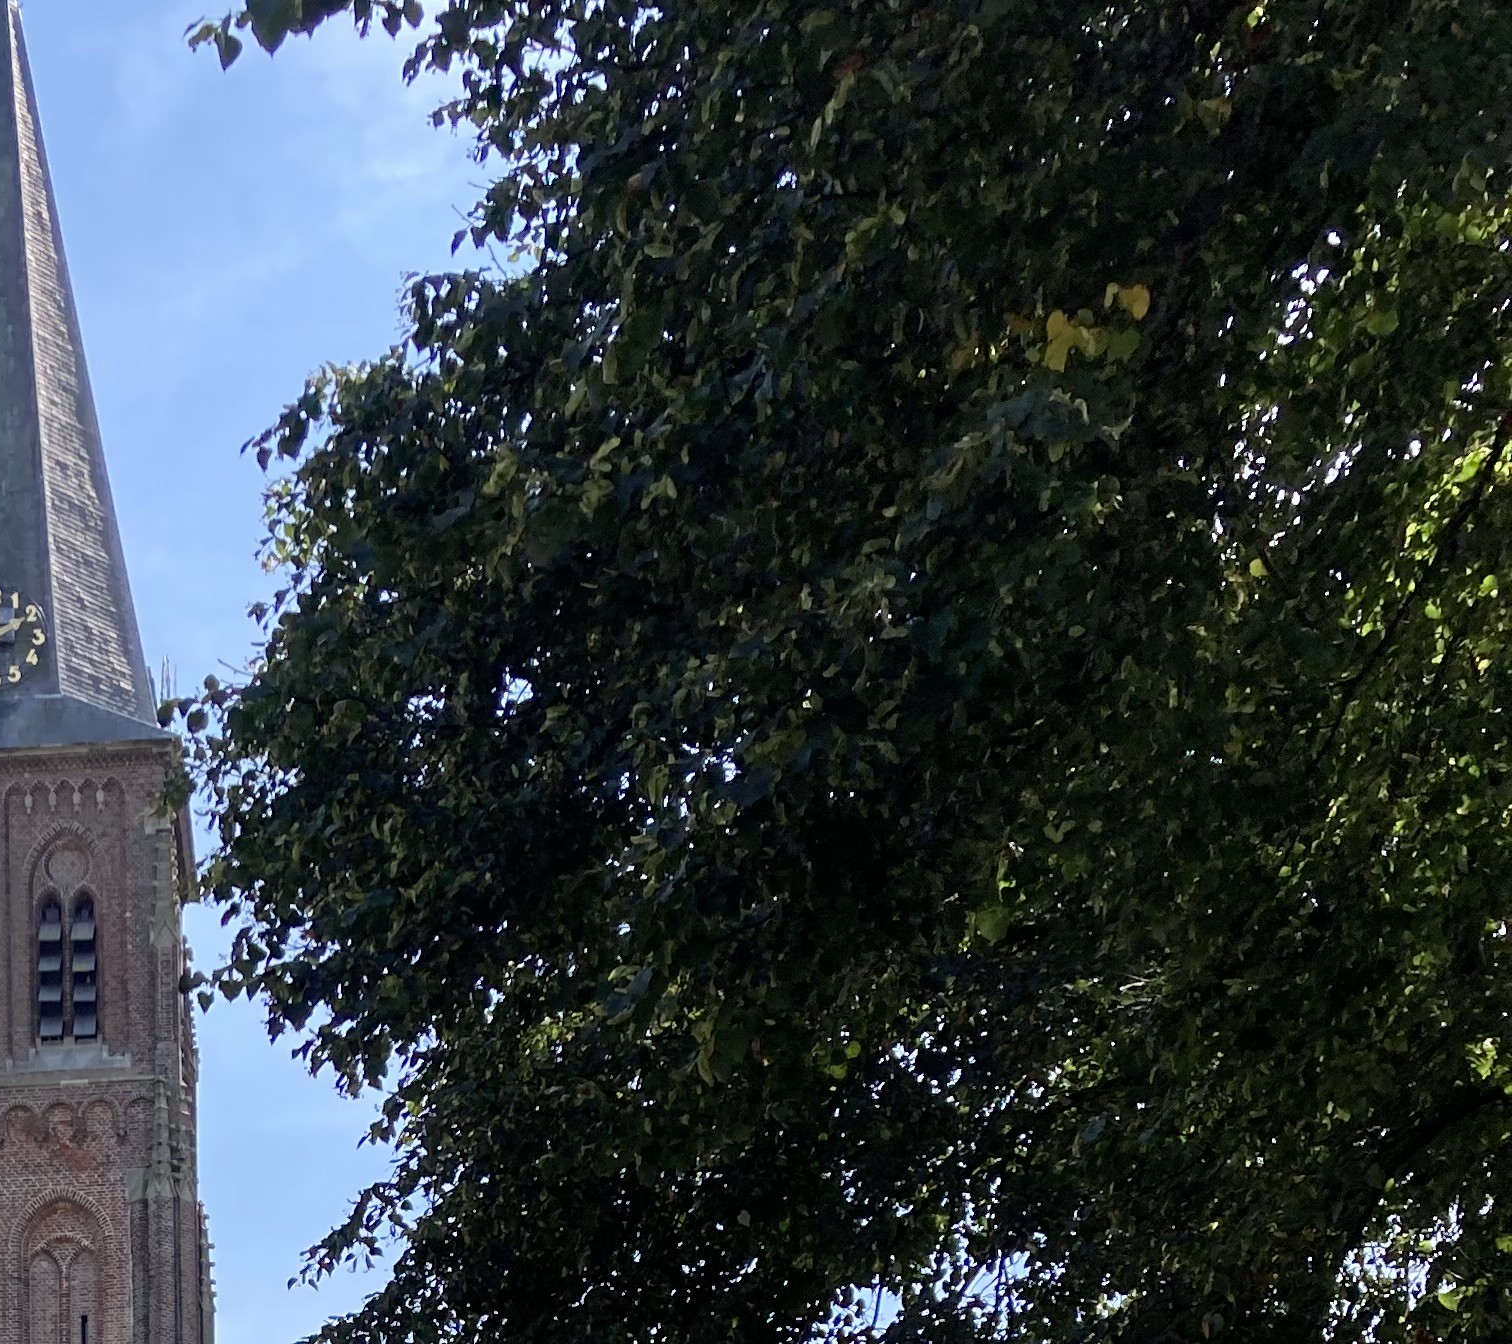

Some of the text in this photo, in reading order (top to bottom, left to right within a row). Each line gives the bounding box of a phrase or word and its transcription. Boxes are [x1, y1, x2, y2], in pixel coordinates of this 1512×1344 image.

[11, 591, 19, 609] 1
[25, 604, 37, 622] 2
[31, 628, 46, 646] 3
[25, 648, 39, 666] 4
[7, 665, 22, 683] 5
